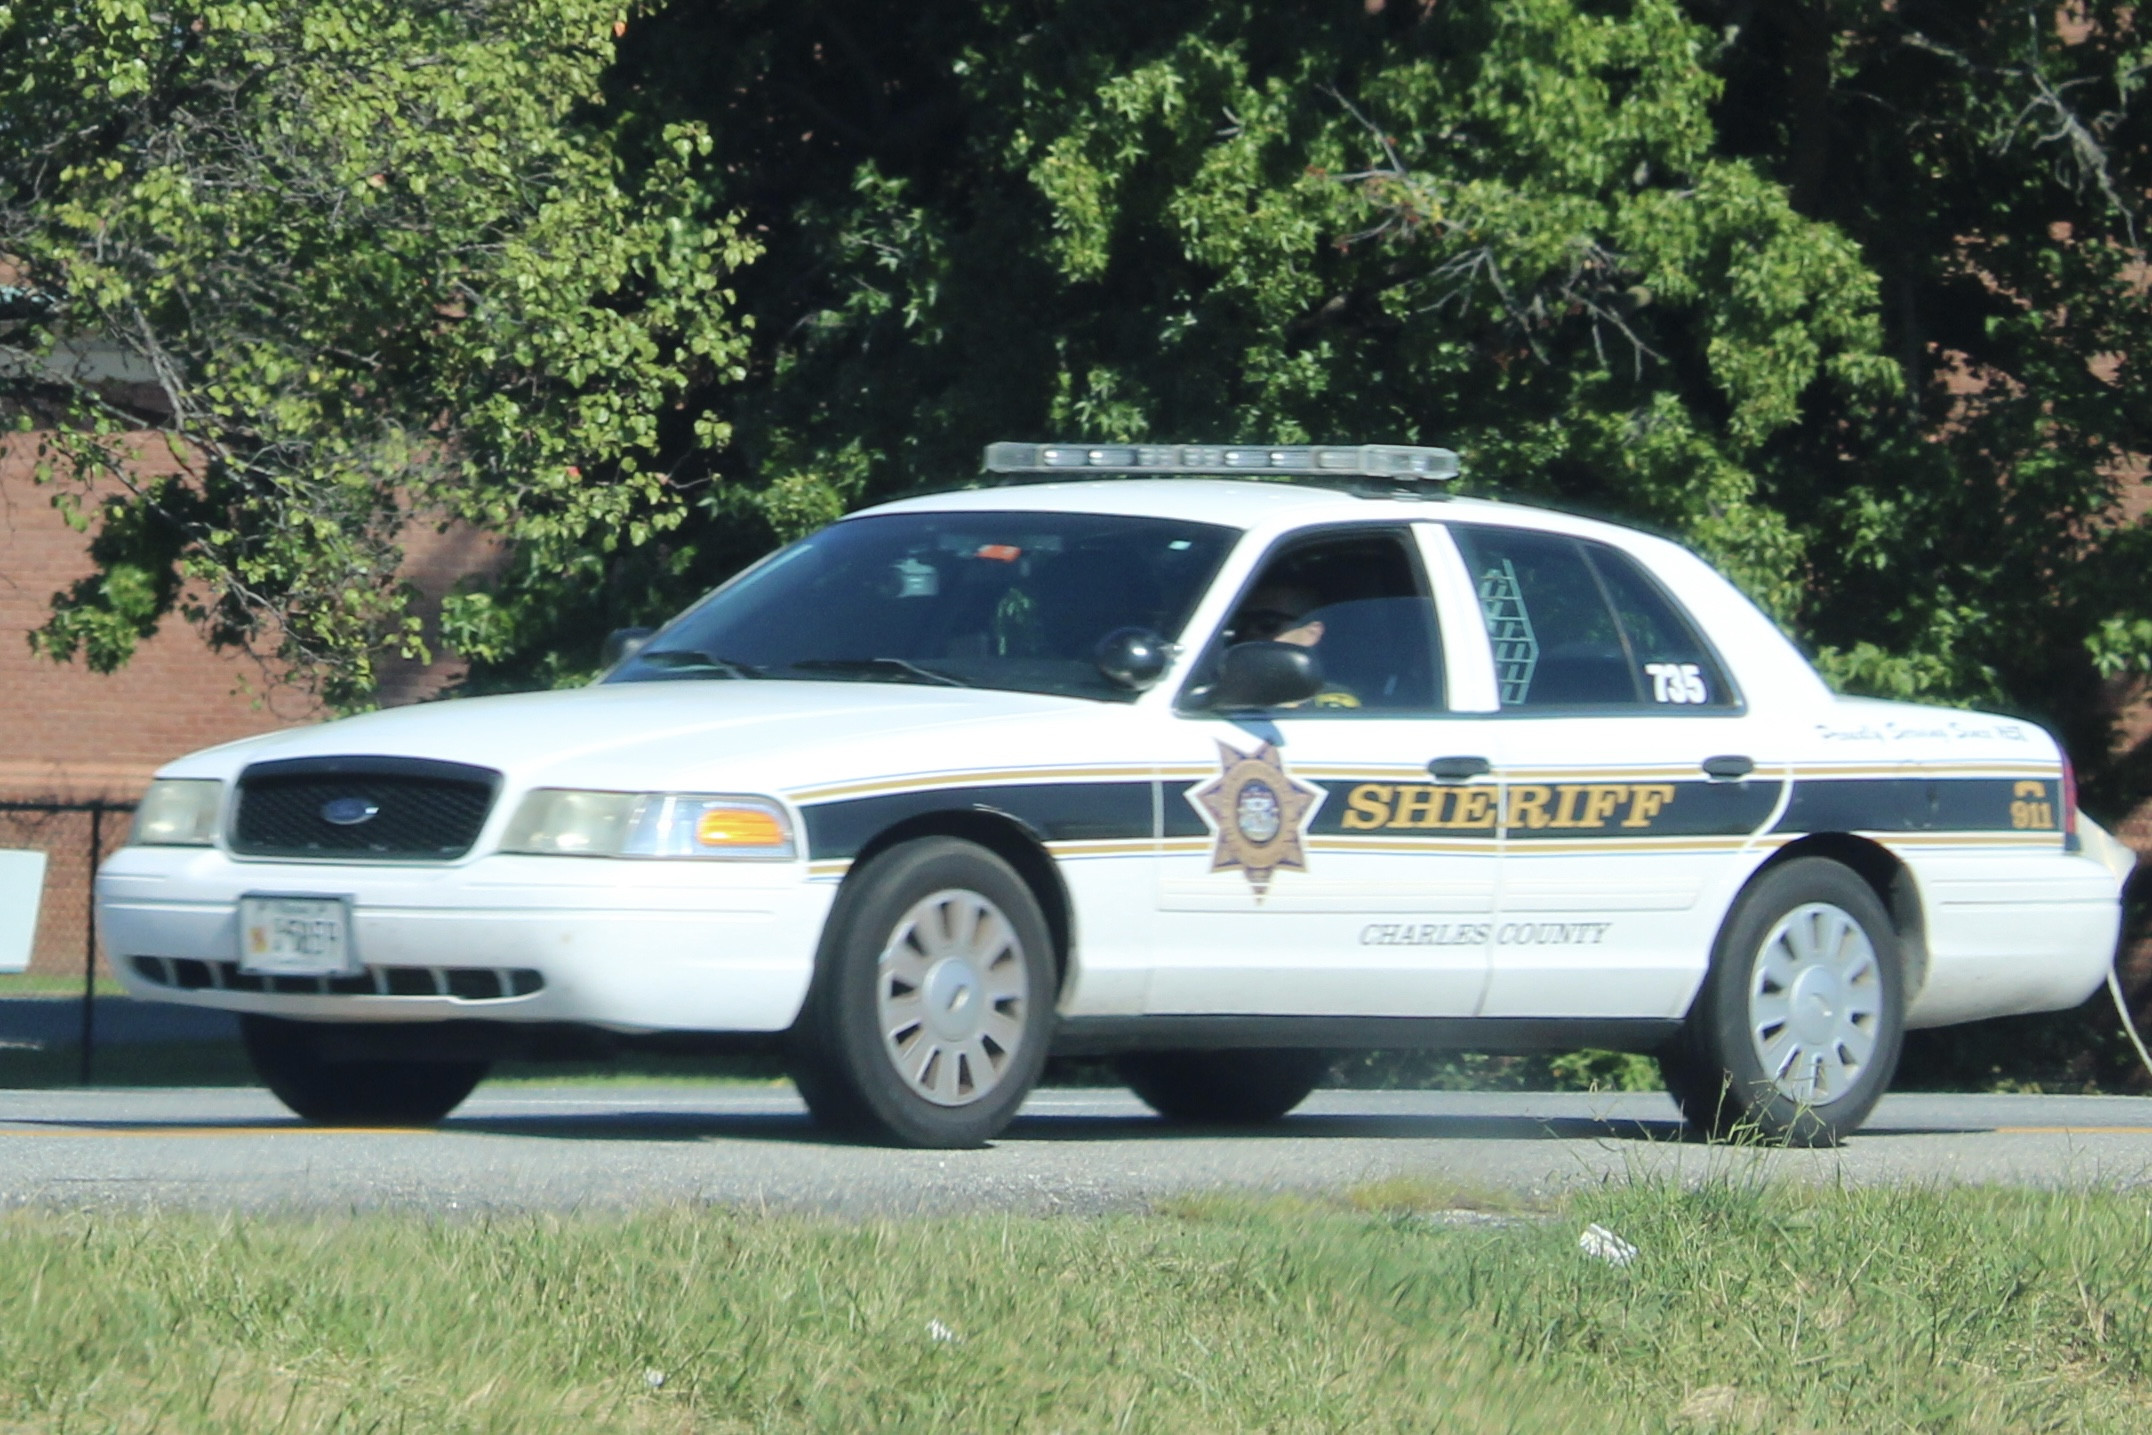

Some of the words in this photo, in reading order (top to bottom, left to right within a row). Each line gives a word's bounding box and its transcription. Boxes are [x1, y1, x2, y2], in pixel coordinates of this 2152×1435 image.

[1644, 663, 1707, 704] 735
[1341, 784, 1675, 829] SHERIFF
[2010, 800, 2054, 829] 911
[1358, 922, 1492, 946] CHARLES
[1495, 921, 1613, 946] COUNTY
